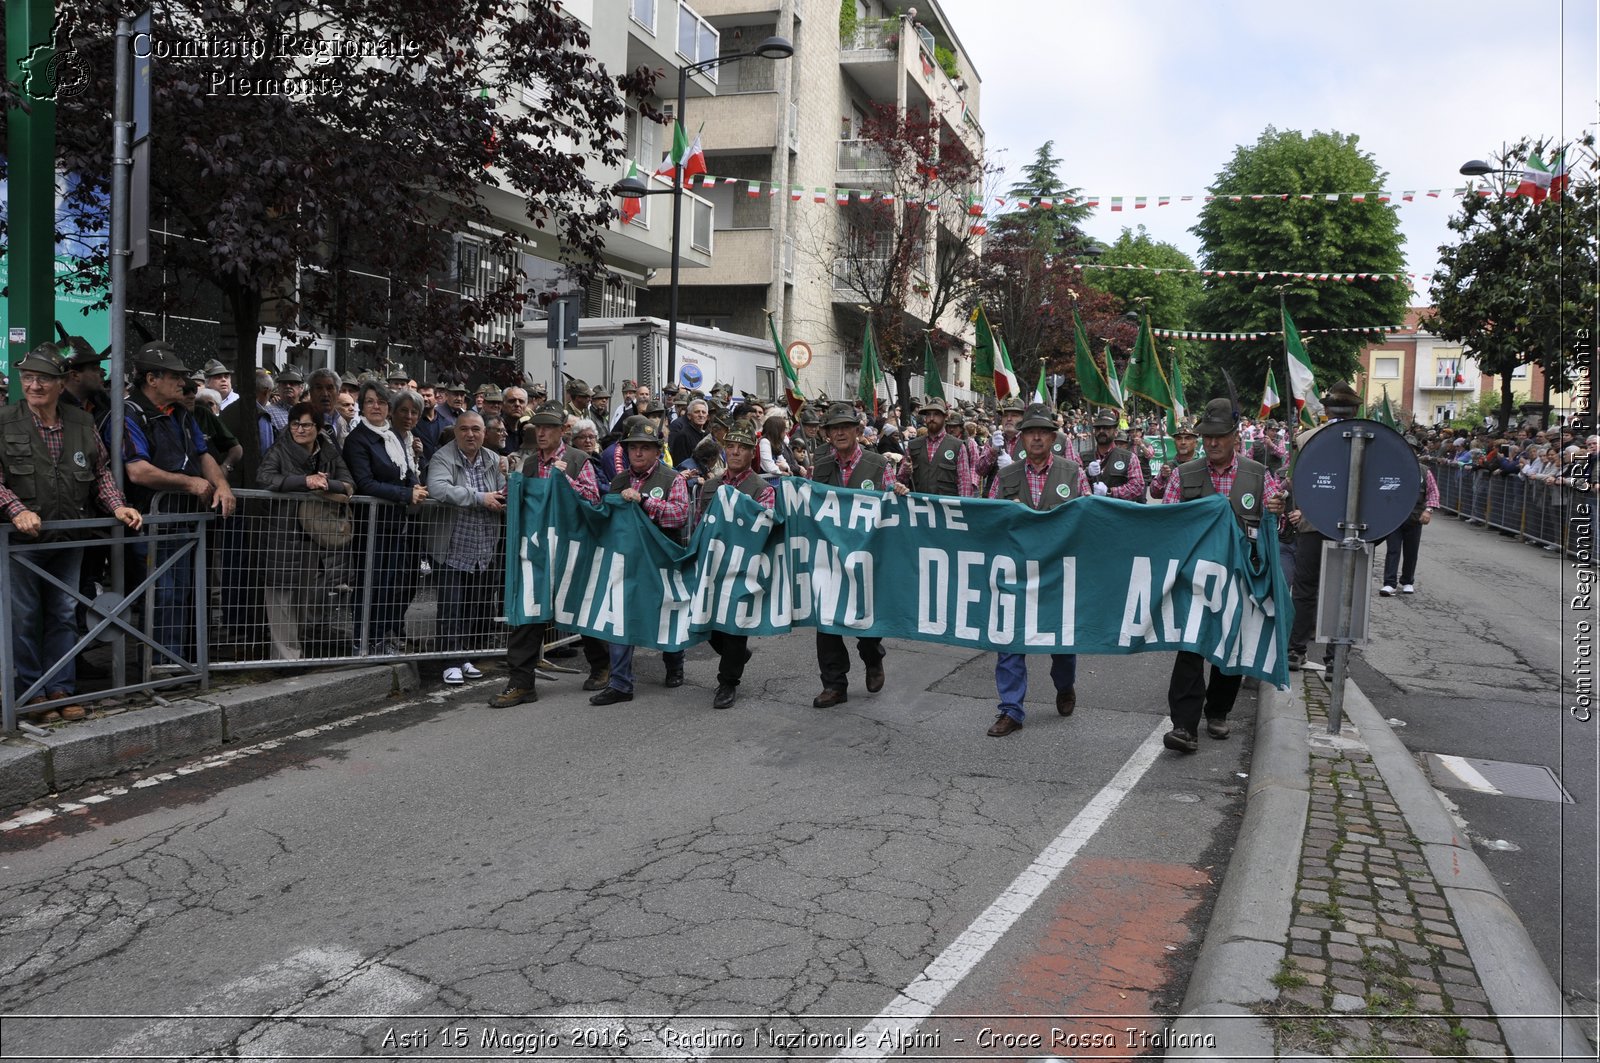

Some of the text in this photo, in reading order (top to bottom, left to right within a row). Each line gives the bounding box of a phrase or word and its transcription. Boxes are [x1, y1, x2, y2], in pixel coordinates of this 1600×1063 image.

[782, 480, 969, 533] MARCHE
[690, 536, 875, 630] BISOGNO
[917, 546, 1077, 647] DEGLI
